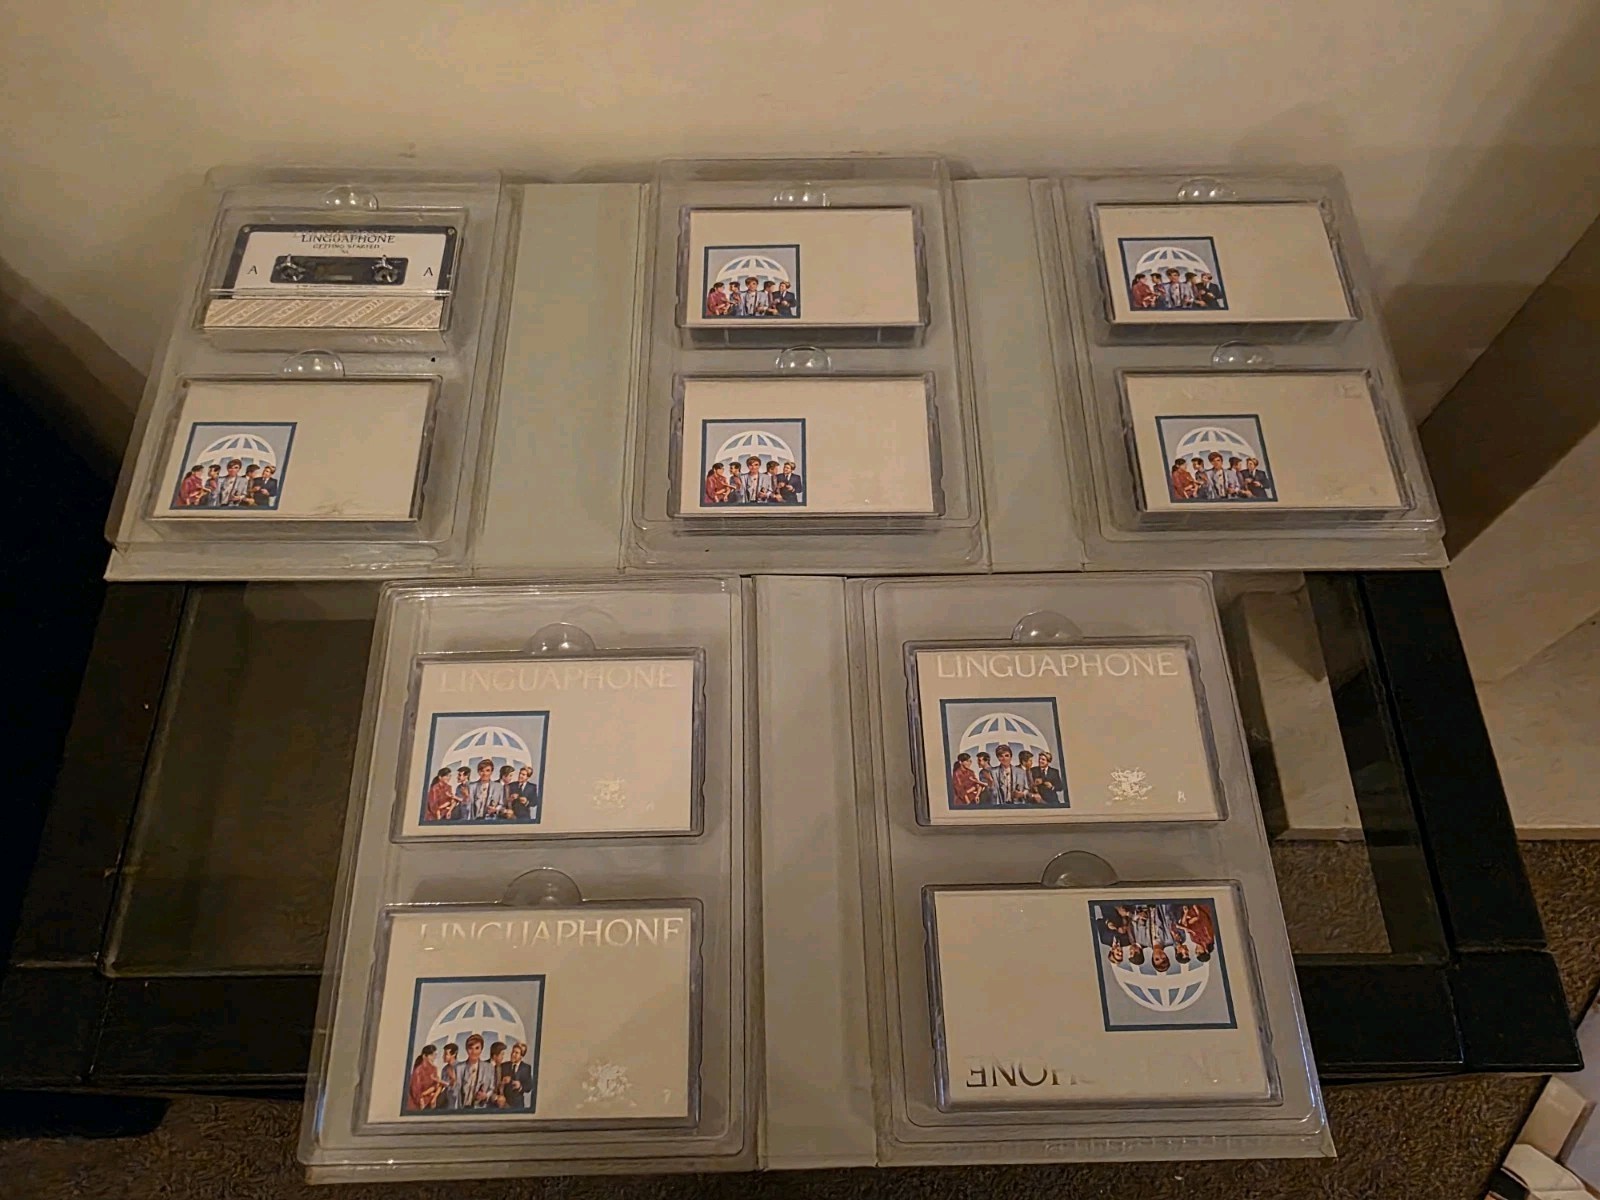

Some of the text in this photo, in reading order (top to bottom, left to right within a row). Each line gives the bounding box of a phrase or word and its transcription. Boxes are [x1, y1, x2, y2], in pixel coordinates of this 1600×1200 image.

[301, 233, 396, 244] LINGUAPHONE
[247, 265, 258, 275] A
[938, 651, 1179, 679] LINGUAPHONE
[438, 664, 679, 693] LINGUAPHONE
